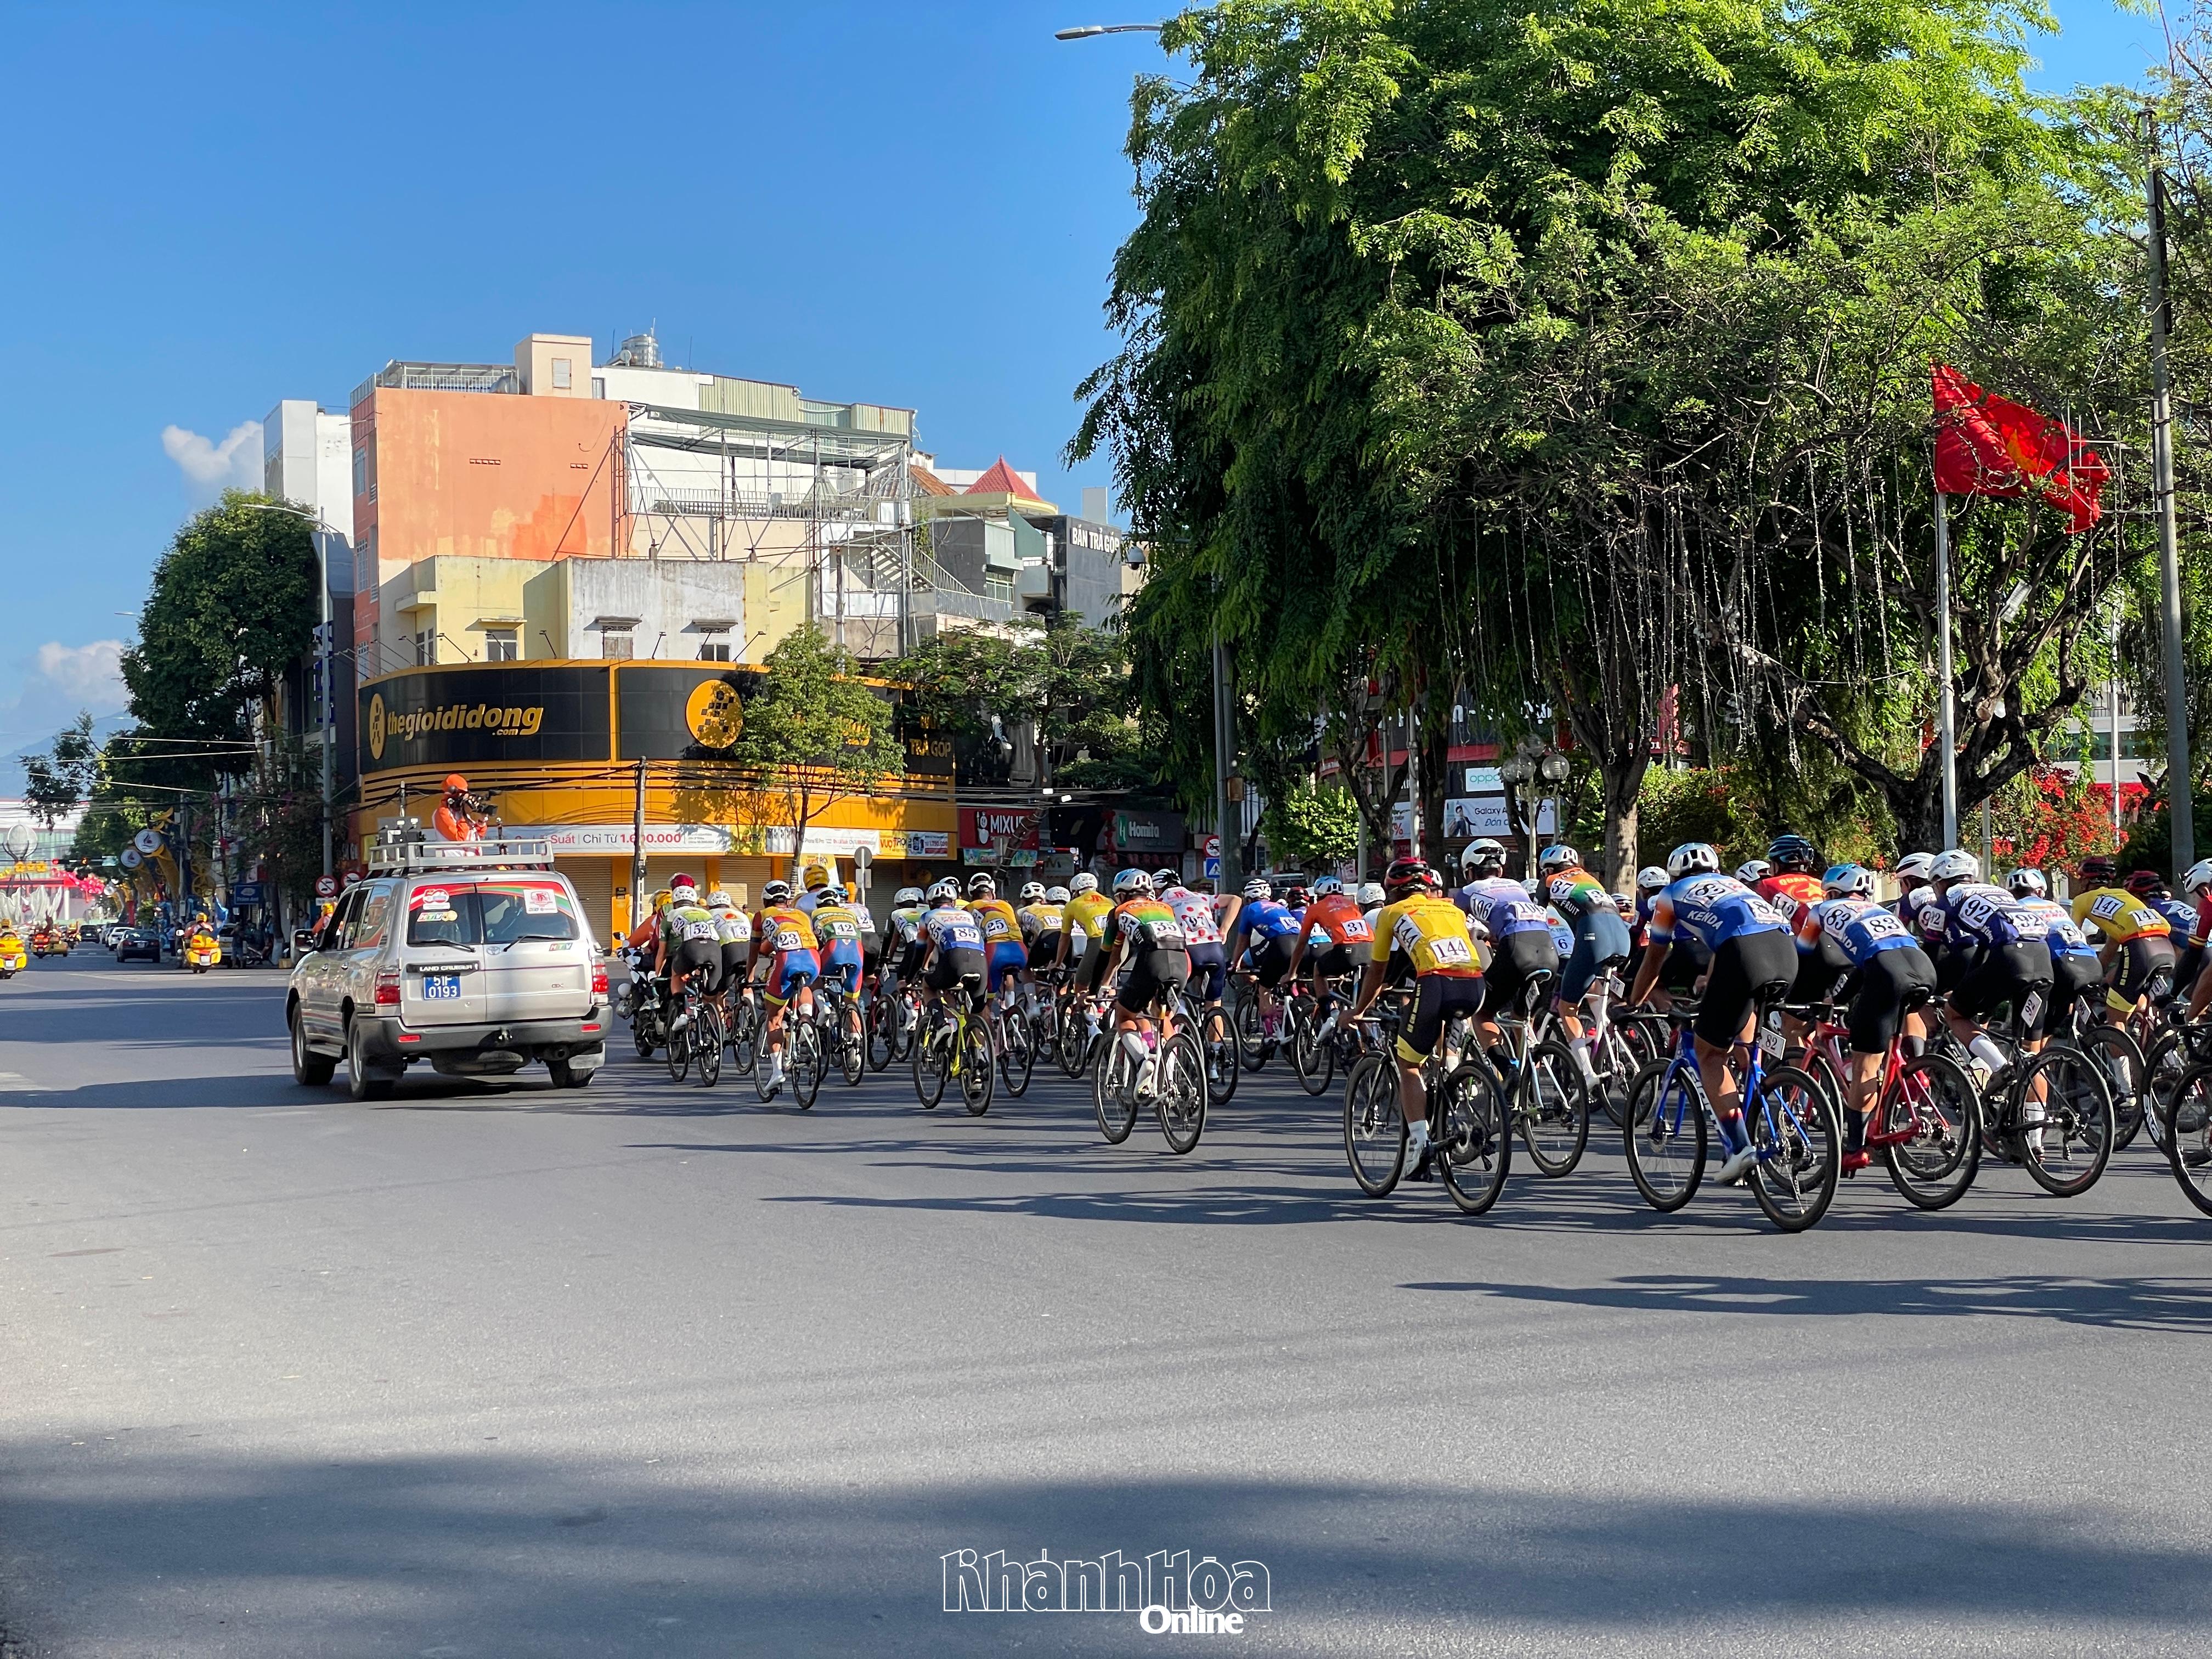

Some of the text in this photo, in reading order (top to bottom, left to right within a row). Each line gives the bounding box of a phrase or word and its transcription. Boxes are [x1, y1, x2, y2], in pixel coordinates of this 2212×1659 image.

[1072, 524, 1120, 554] BÁN TRẢ GÓP
[387, 704, 544, 741] thegioididong
[1485, 817, 1502, 826] Đón
[1128, 821, 1160, 838] Homita
[550, 832, 576, 844] Suất
[583, 832, 601, 844] Chỉ
[605, 831, 618, 843] Từ
[1551, 881, 1573, 895] 37
[1695, 883, 1726, 901] 82
[1472, 899, 1493, 919] 106
[1560, 900, 1581, 916] FRUIT
[1965, 899, 1991, 924] 92
[2094, 898, 2120, 915] 141
[1686, 910, 1724, 930] KENDA
[1826, 909, 1852, 931] 83
[2015, 913, 2042, 928] 92
[2134, 910, 2158, 922] 141
[693, 924, 709, 935] 52
[763, 920, 775, 937] 23
[837, 924, 854, 932] 42
[988, 920, 1005, 933] 25
[1156, 922, 1177, 932] 35
[1347, 922, 1365, 933] 31
[1869, 917, 1900, 933] 83
[780, 933, 799, 946] 23
[958, 928, 977, 938] 85
[1396, 918, 1419, 950] 144
[549, 943, 573, 951] HTV
[1434, 940, 1469, 959] 144
[1558, 938, 1568, 950] 6
[433, 976, 452, 986] 51F
[428, 986, 457, 998] 0193
[2024, 999, 2036, 1016] 92
[1765, 1034, 1778, 1051] 82
